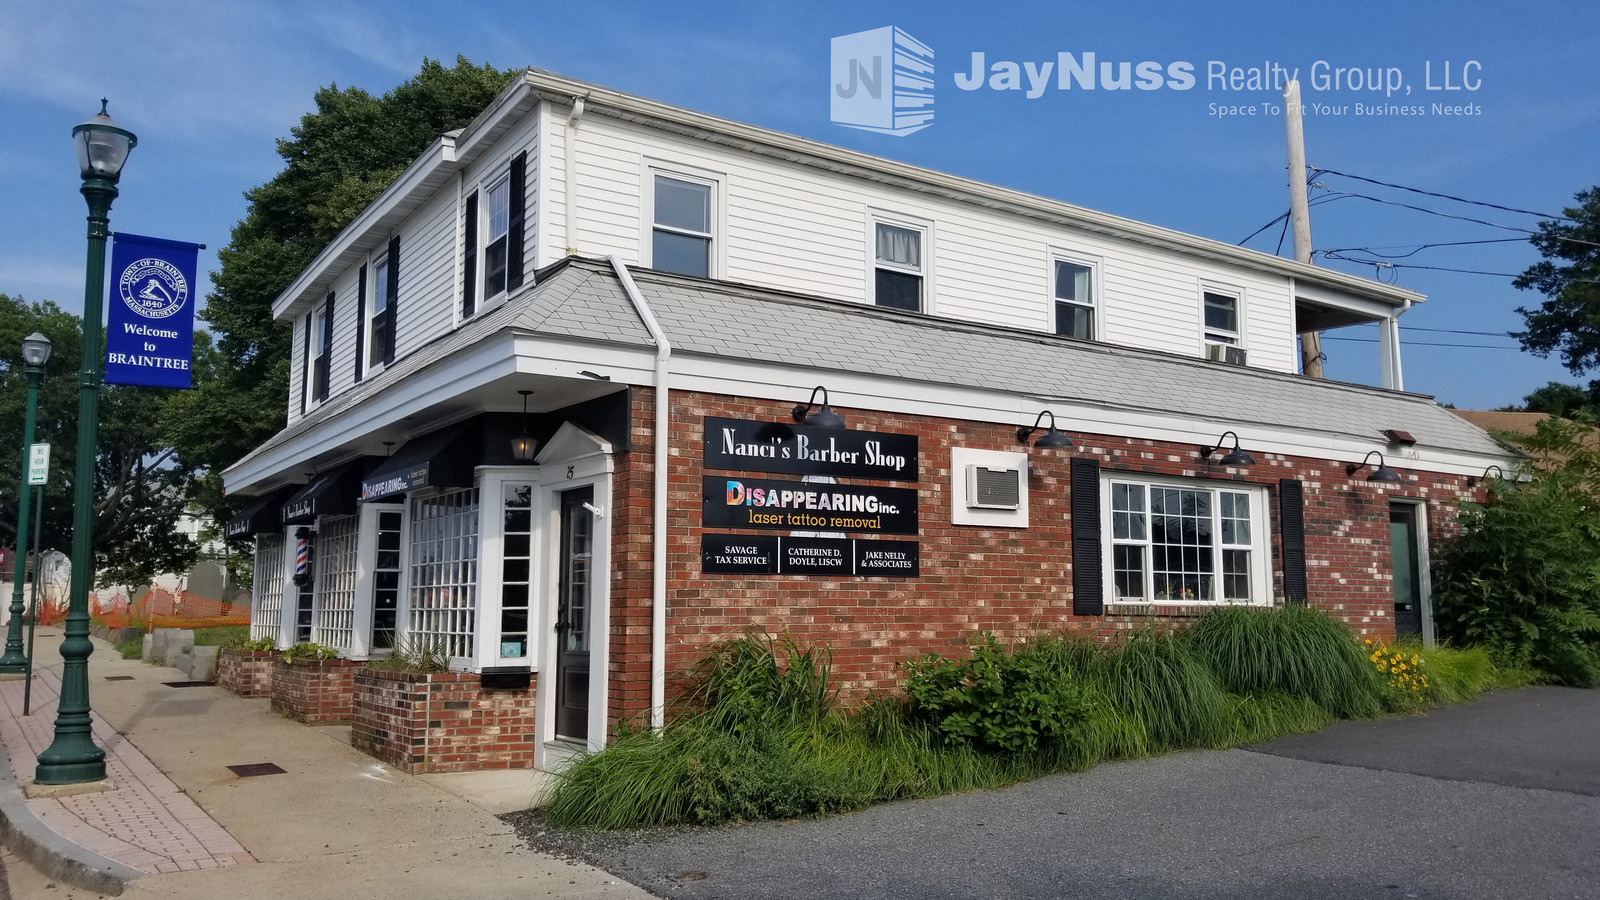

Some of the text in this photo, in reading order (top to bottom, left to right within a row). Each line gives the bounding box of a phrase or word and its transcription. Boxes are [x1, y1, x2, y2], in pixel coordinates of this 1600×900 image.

[121, 264, 138, 285] TOWN
[154, 260, 186, 293] BRAINTREE
[125, 297, 180, 317] MASSACHUSETTS
[142, 300, 162, 309] 1640
[123, 323, 178, 339] Welcome
[144, 341, 156, 352] to
[108, 353, 189, 370] BRAINTREE
[721, 428, 906, 471] Nanci's Barber Shop
[566, 465, 575, 480] 25
[749, 510, 881, 529] laser tattoo removal
[725, 546, 758, 555] SAVAGE
[788, 548, 842, 557] CATHERINE D.
[865, 551, 906, 561] JAKE NELLY
[715, 555, 767, 565] TAX SERVICE
[789, 557, 843, 567] DOYLE, LISCW
[861, 559, 912, 569] & ASSOCIATES
